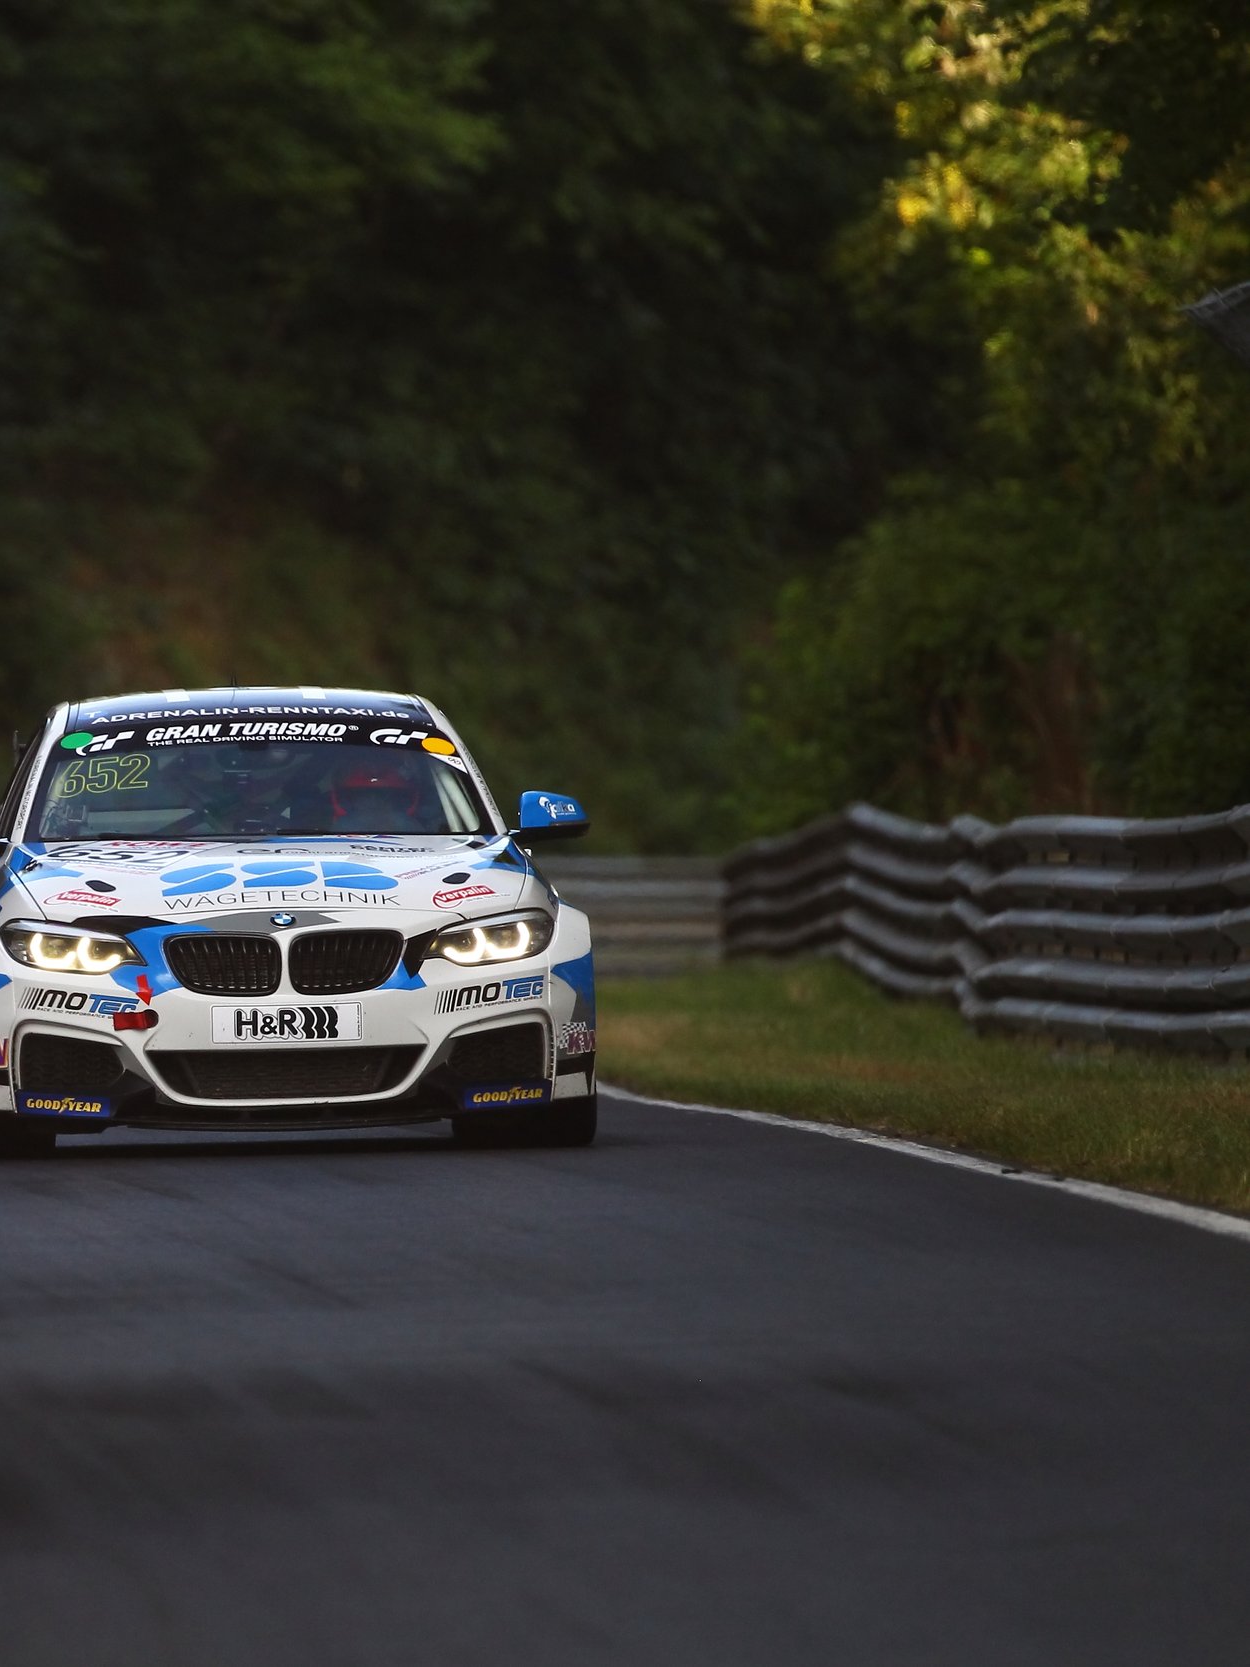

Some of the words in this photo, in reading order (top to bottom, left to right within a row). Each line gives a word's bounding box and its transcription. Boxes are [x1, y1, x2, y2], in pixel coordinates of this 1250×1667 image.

[91, 706, 410, 724] ADRENALIN-RENNTAXI.de
[146, 723, 226, 742] GRAN
[175, 737, 211, 745] REAL
[55, 753, 150, 798] 652
[46, 844, 190, 865] 652
[164, 889, 401, 910] WÄGETECHNIK
[234, 1008, 303, 1040] H&R
[472, 1087, 544, 1103] GOODYEAR
[26, 1097, 102, 1114] GOODYEAR
